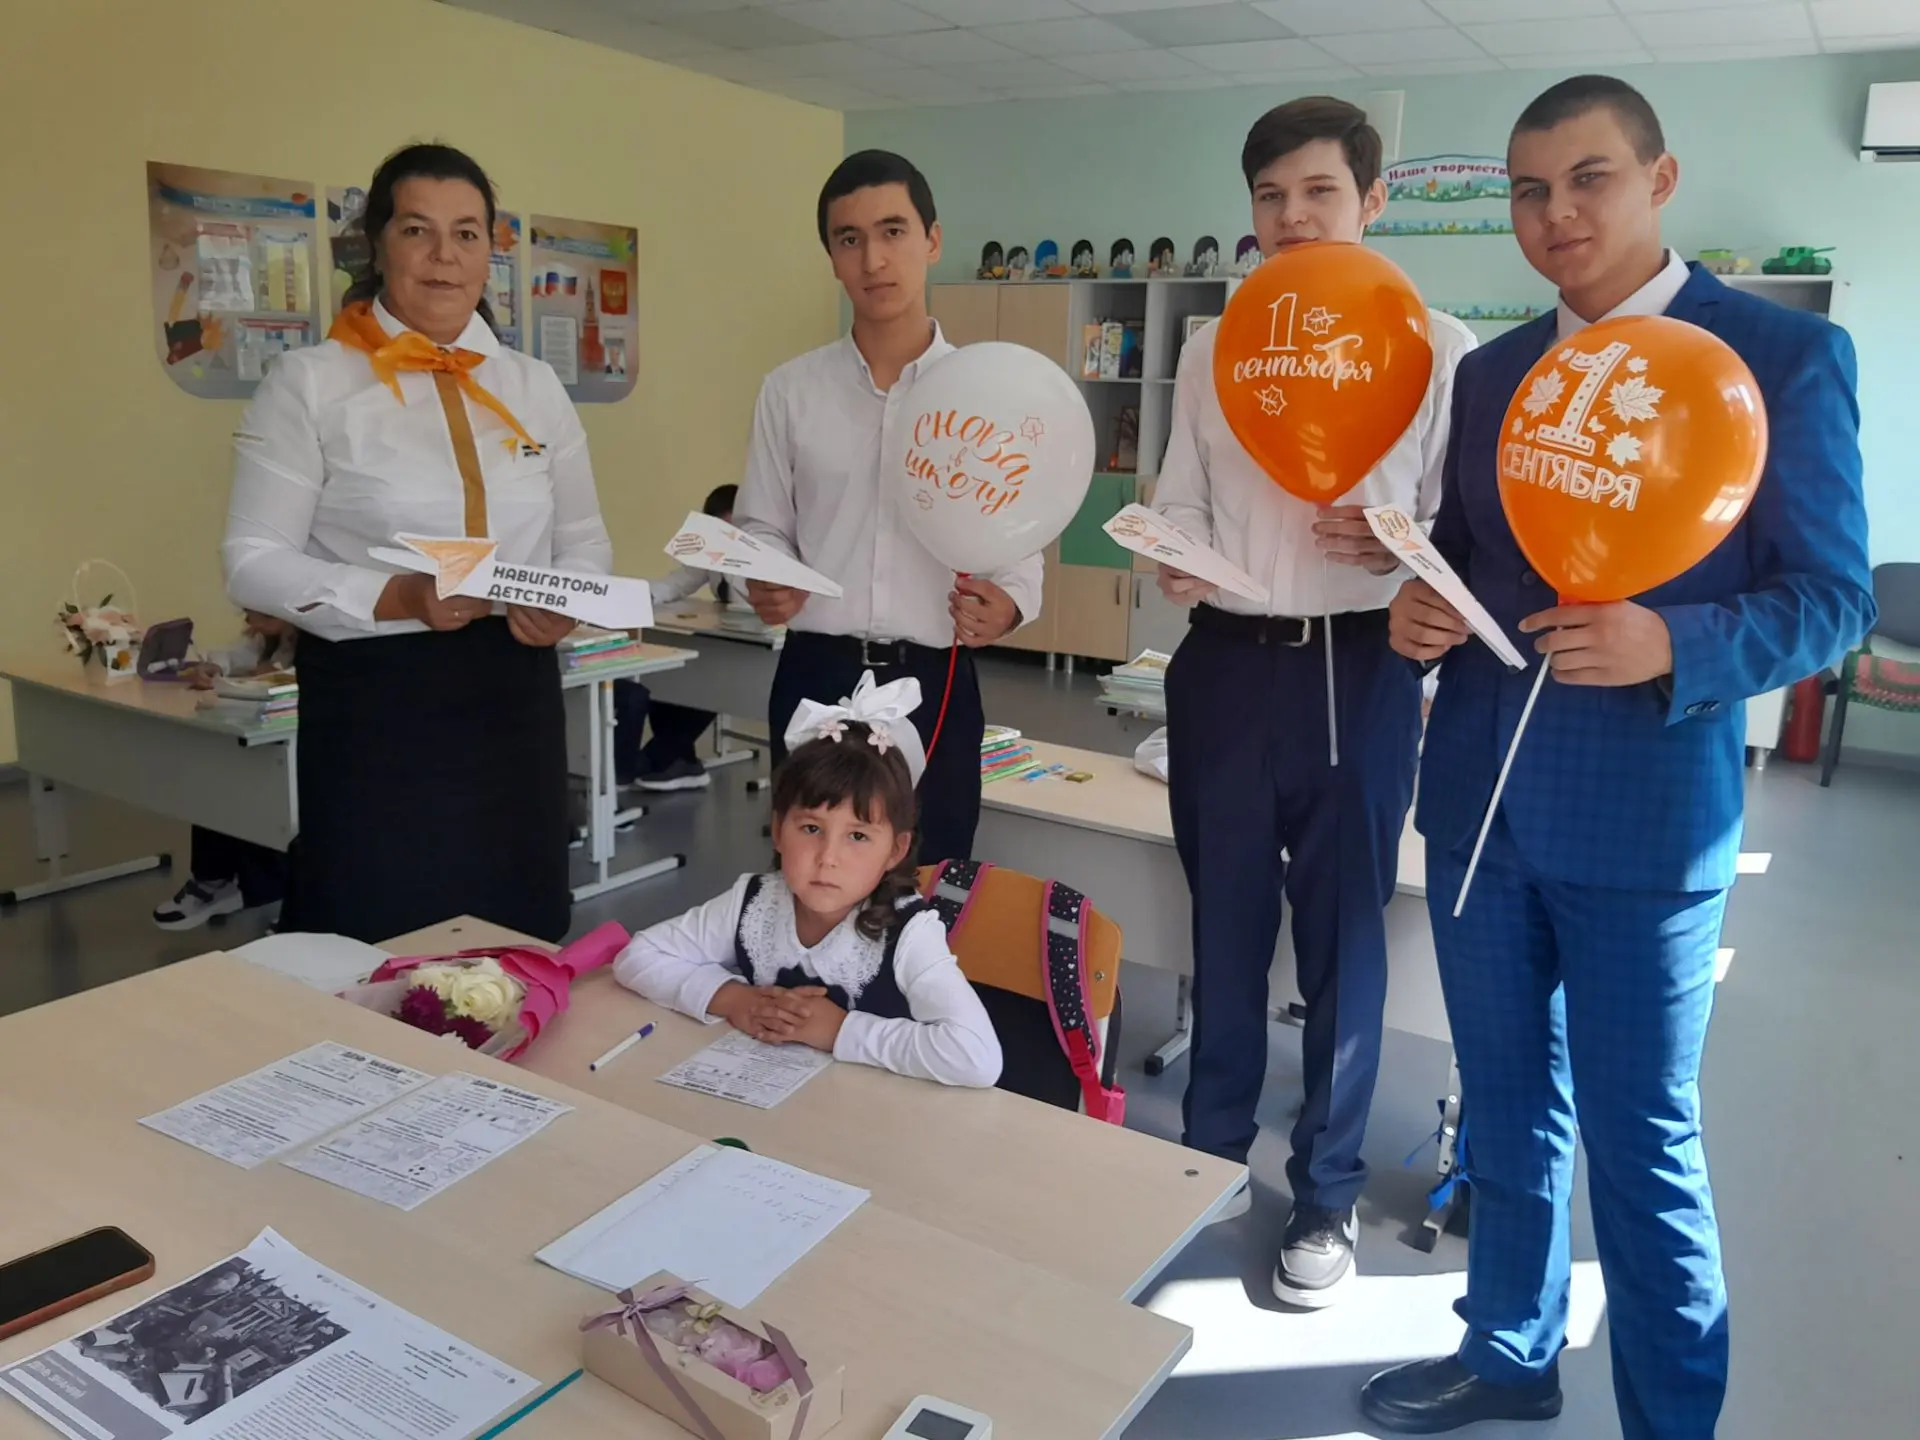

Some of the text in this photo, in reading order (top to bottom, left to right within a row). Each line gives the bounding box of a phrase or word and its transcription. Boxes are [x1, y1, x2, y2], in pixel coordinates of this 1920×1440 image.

[1388, 164, 1510, 181] Наше творчеств
[1262, 293, 1299, 351] 1
[1233, 334, 1373, 391] сентября
[1536, 341, 1631, 457] 1
[1502, 443, 1643, 512] СЕНТЯБРЯ
[487, 584, 568, 607] ДЕТСТВА
[493, 565, 609, 596] НАВИГАТОРЫ
